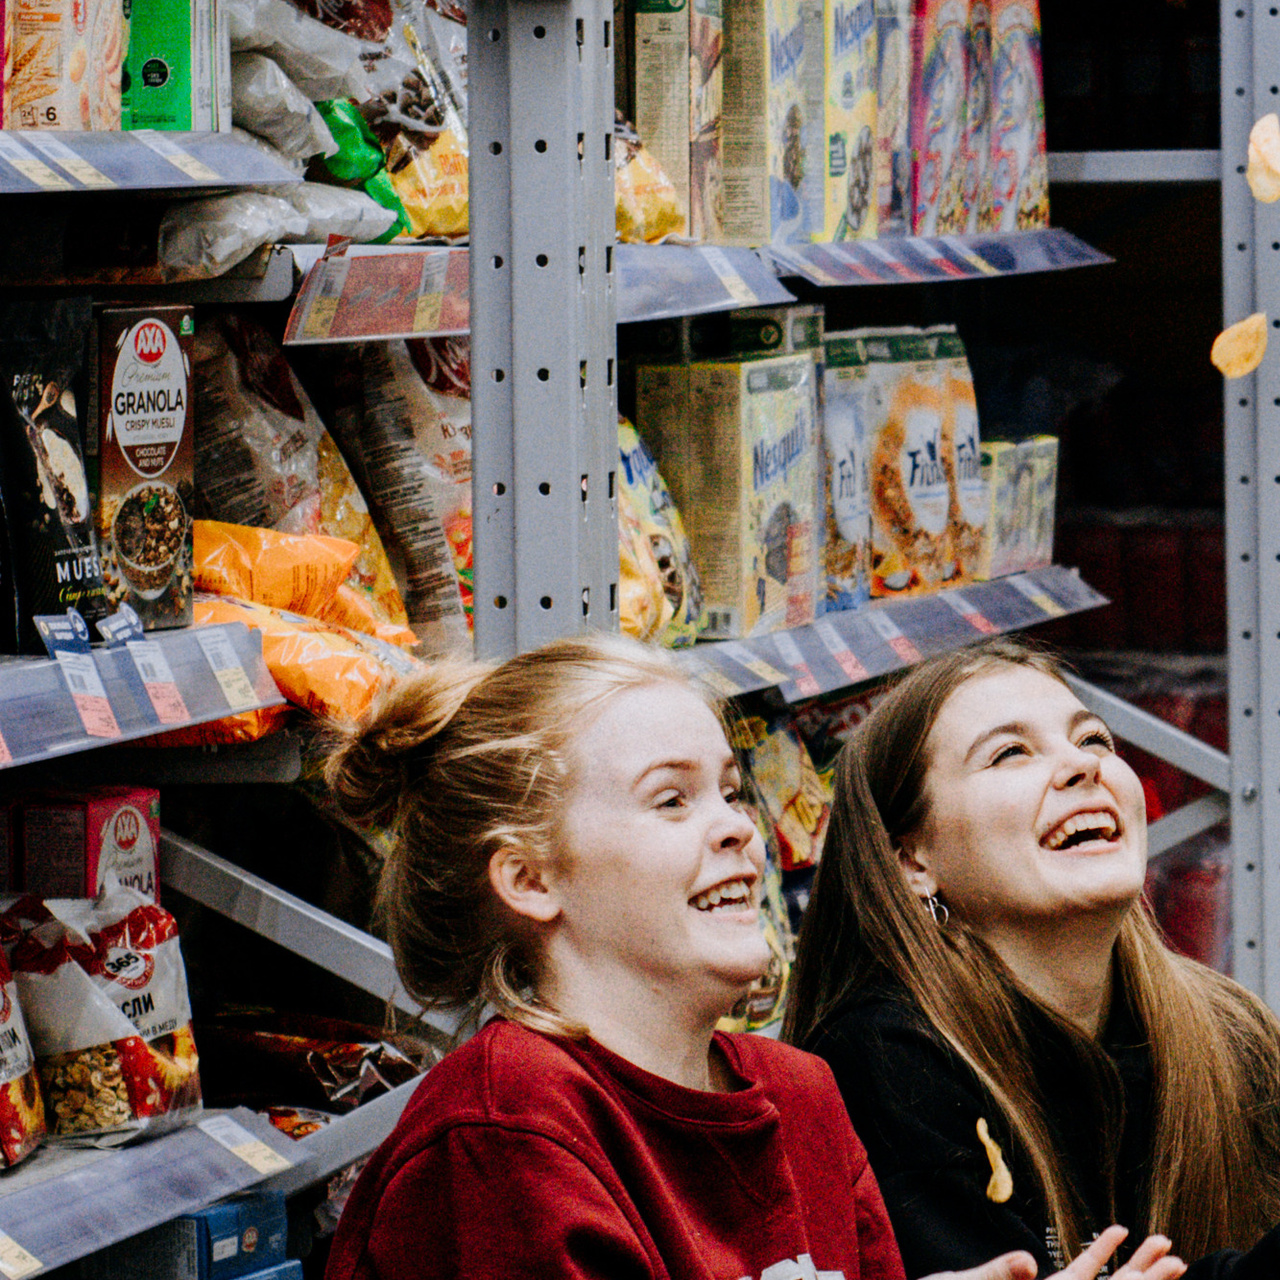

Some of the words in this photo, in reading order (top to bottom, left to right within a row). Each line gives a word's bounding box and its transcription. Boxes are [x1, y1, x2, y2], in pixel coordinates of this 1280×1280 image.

[137, 326, 164, 354] AXA
[121, 363, 171, 388] Premium
[115, 389, 184, 415] GRANOLA
[125, 420, 149, 432] CRISPY
[152, 417, 176, 429] MUESLI
[135, 447, 167, 458] CHOCOLATE
[151, 457, 165, 467] NUTS
[105, 952, 140, 974] 365
[121, 992, 155, 1019] СЛИ
